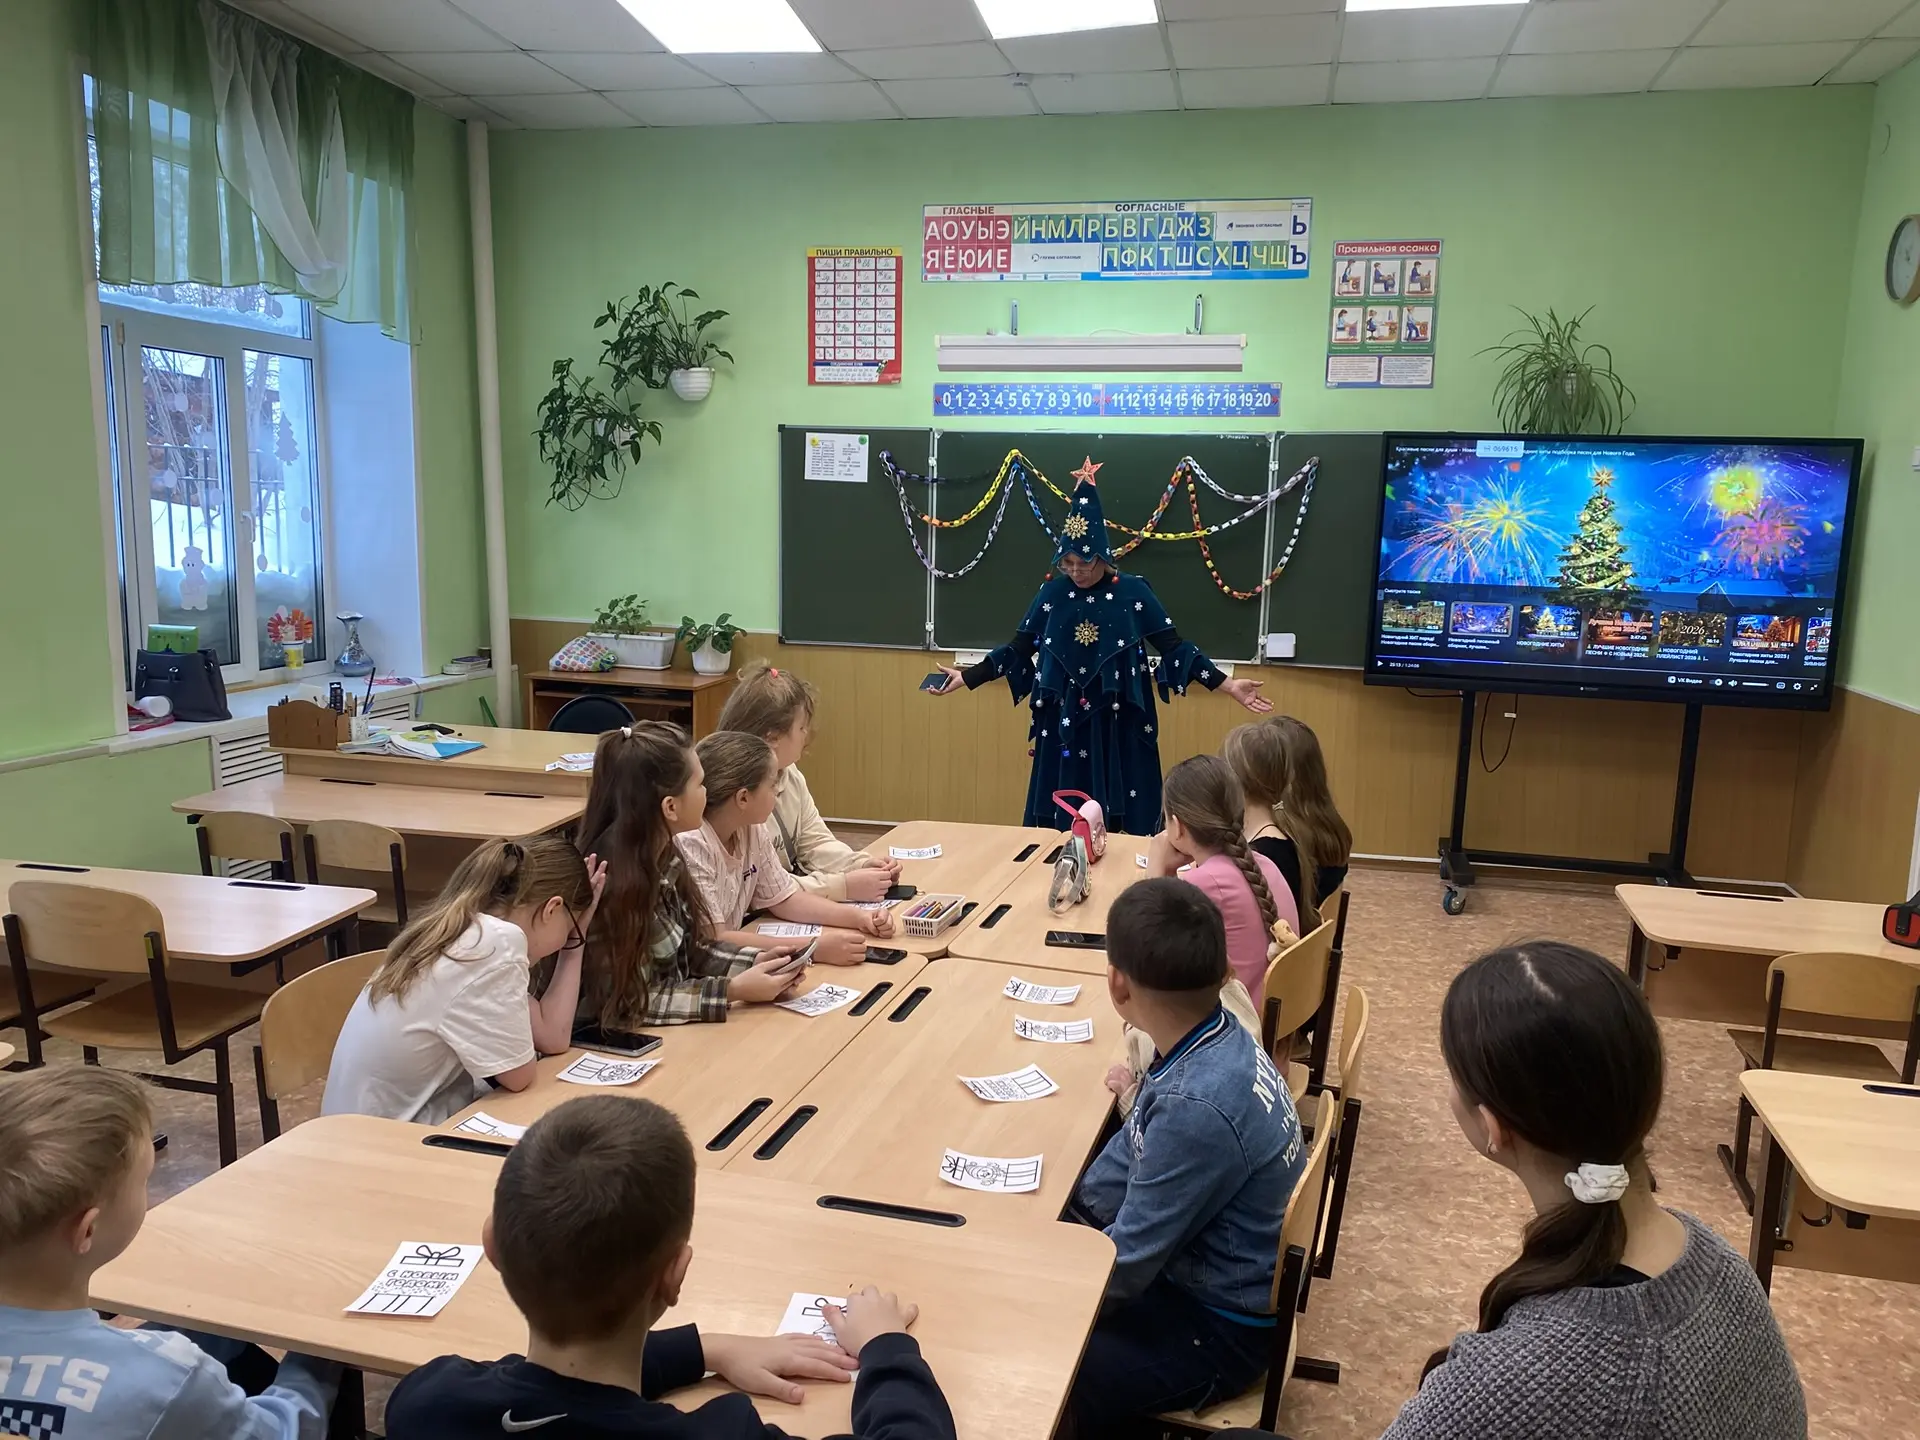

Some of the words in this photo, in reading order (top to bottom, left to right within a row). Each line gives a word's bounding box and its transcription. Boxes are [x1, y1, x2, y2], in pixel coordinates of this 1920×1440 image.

[943, 206, 994, 215] ГЛАСНЫЕ
[1115, 203, 1185, 212] СОГЛАСНЫЕ
[844, 248, 893, 256] ПРАВИЛЬНО
[1338, 244, 1396, 254] Правильная
[942, 392, 951, 407] 0
[956, 392, 962, 407] 1
[968, 392, 976, 407] 2
[982, 392, 990, 407] 3
[995, 392, 1003, 407] 4
[1009, 392, 1017, 407] 5
[1022, 392, 1030, 407] 6
[1035, 392, 1044, 407] 7
[1048, 392, 1056, 407] 8
[1062, 392, 1070, 407] 9
[1075, 392, 1092, 407] 10
[1112, 393, 1124, 407] 11
[1127, 393, 1140, 407] 12
[1143, 393, 1156, 407] 13
[1158, 393, 1172, 407] 14
[1174, 393, 1188, 407] 15
[1190, 393, 1204, 407] 16
[1207, 393, 1220, 407] 17
[1223, 393, 1236, 407] 18
[1240, 393, 1253, 407] 19
[1255, 393, 1271, 407] 20
[1680, 624, 1705, 635] 2026
[400, 1270, 459, 1280] НОВЫМ
[385, 1279, 446, 1289] ГОДОМ!
